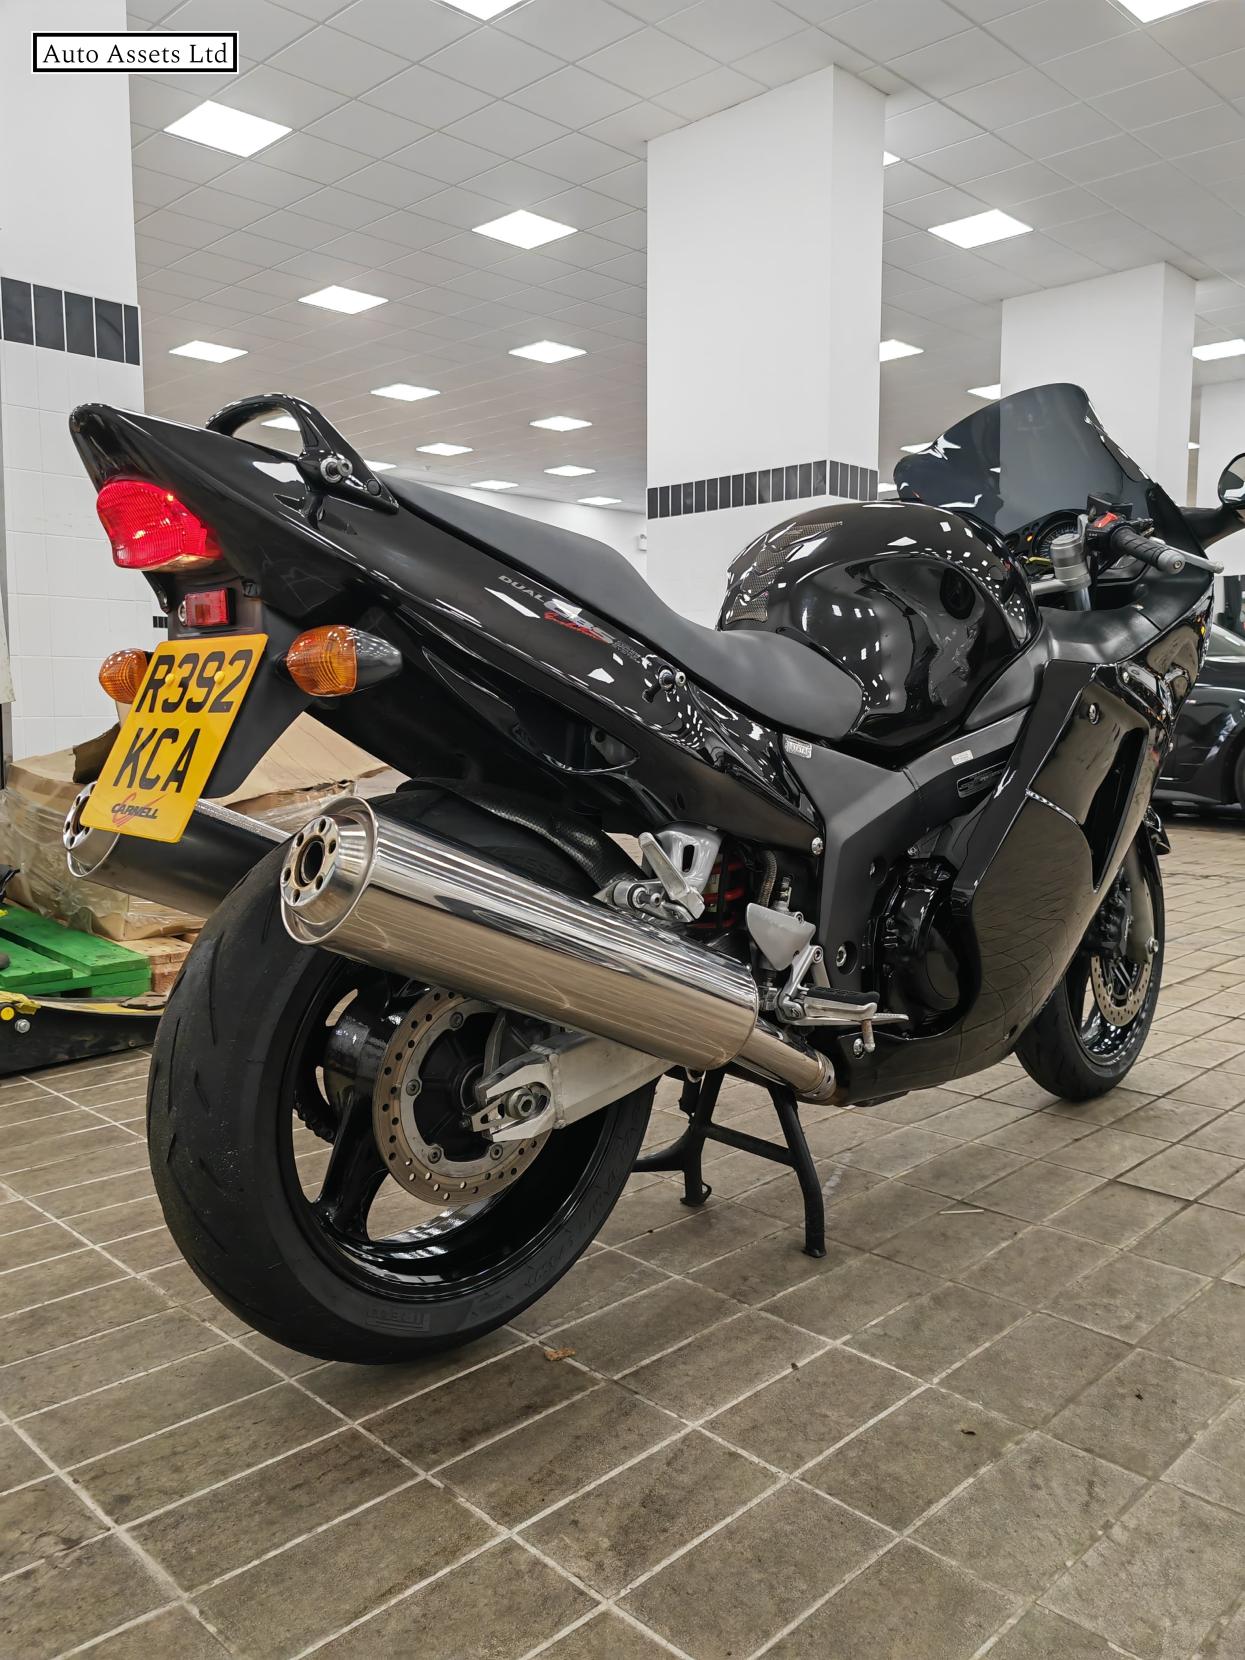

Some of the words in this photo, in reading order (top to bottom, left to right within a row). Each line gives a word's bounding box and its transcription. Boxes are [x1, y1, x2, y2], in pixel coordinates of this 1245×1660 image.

[498, 575, 545, 602] DUAL
[135, 649, 253, 713] R392
[113, 728, 201, 793] KCA
[111, 803, 160, 819] CARNELL
